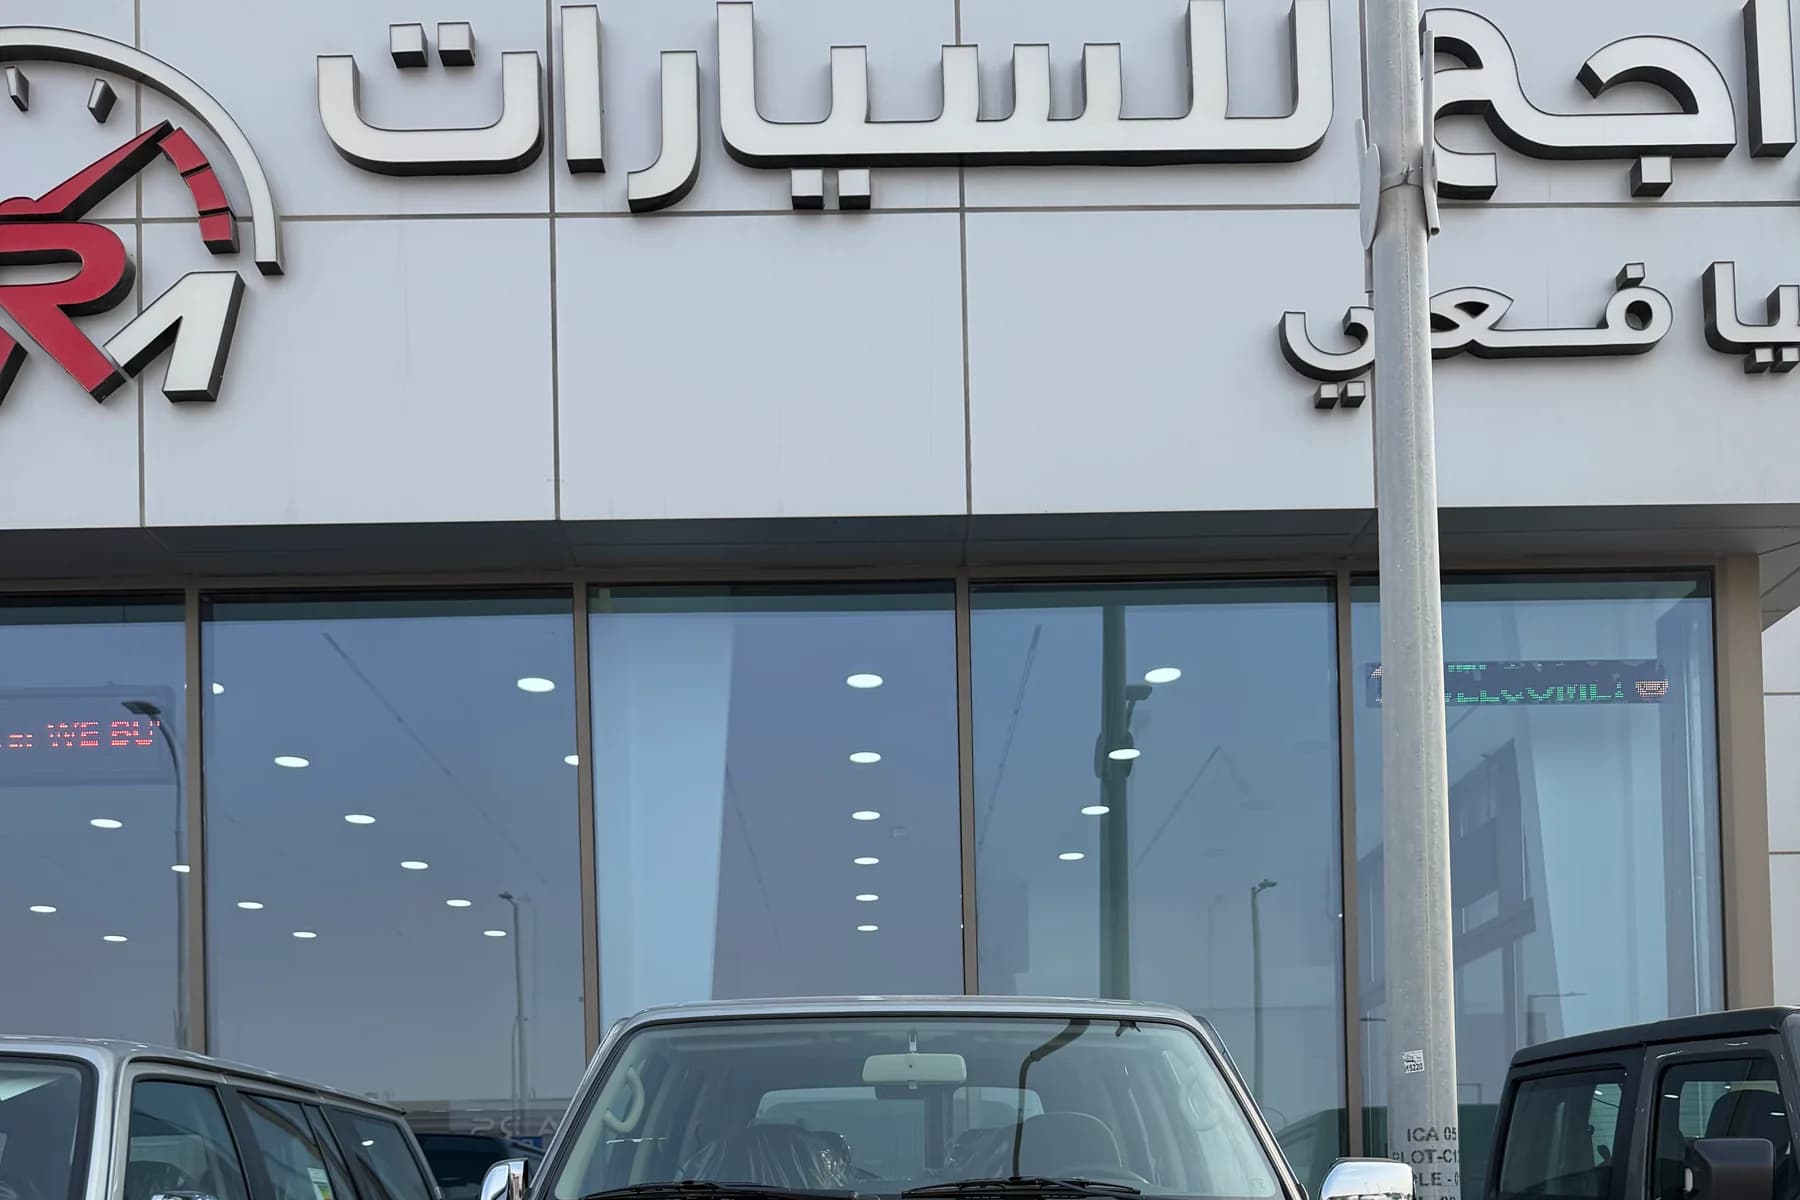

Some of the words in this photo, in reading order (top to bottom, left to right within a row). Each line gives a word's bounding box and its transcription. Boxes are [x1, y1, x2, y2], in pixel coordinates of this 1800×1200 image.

[316, 0, 1333, 214] للسيارات
[47, 721, 99, 747] WE
[1407, 1127, 1440, 1142] ICA
